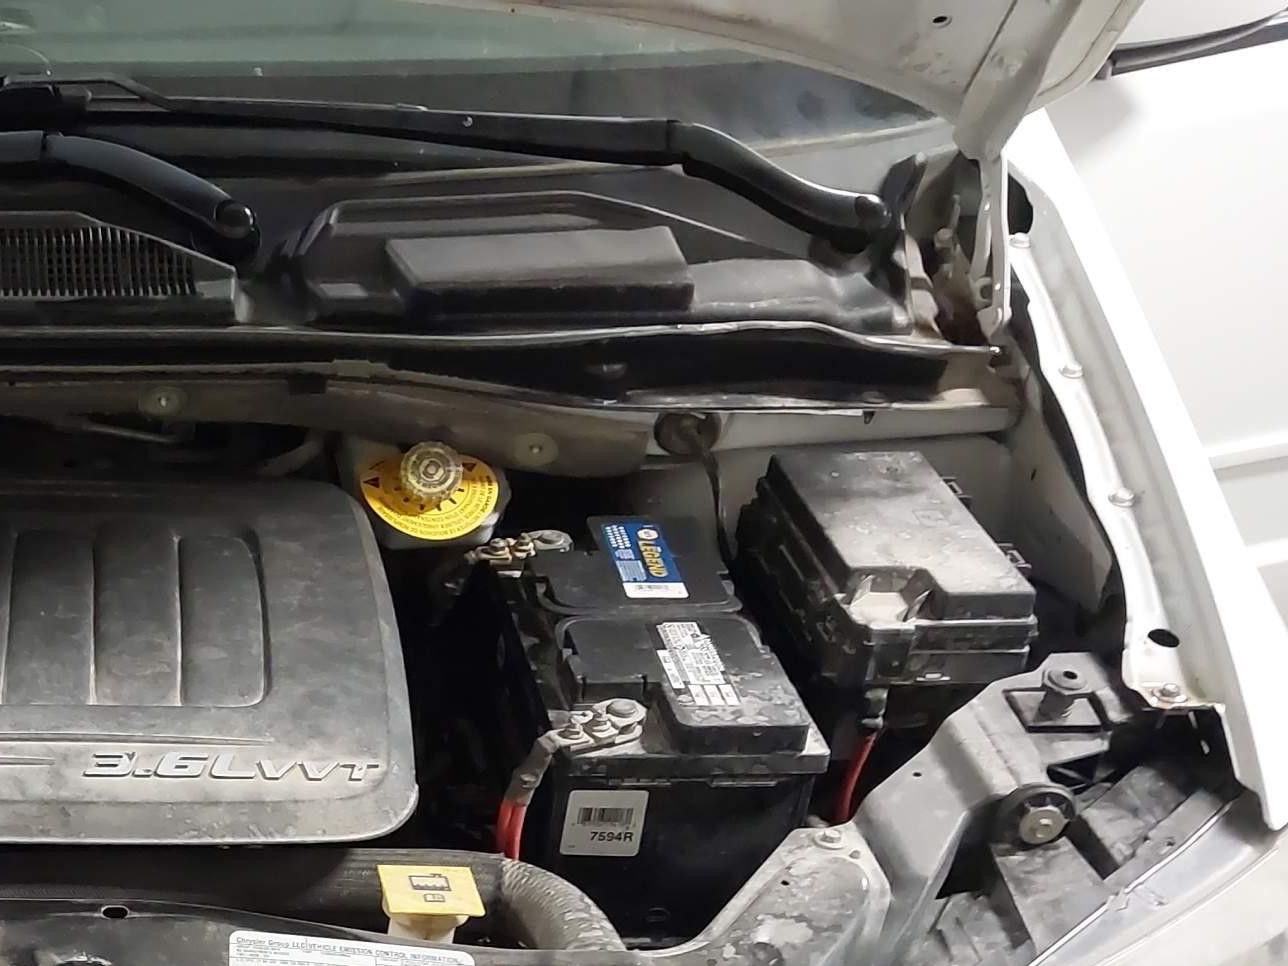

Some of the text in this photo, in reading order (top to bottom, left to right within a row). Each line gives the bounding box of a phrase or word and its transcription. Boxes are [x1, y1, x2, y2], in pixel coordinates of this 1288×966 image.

[638, 540, 668, 578] LEGEND
[590, 831, 634, 842] 7594R
[236, 936, 266, 946] Chrysler
